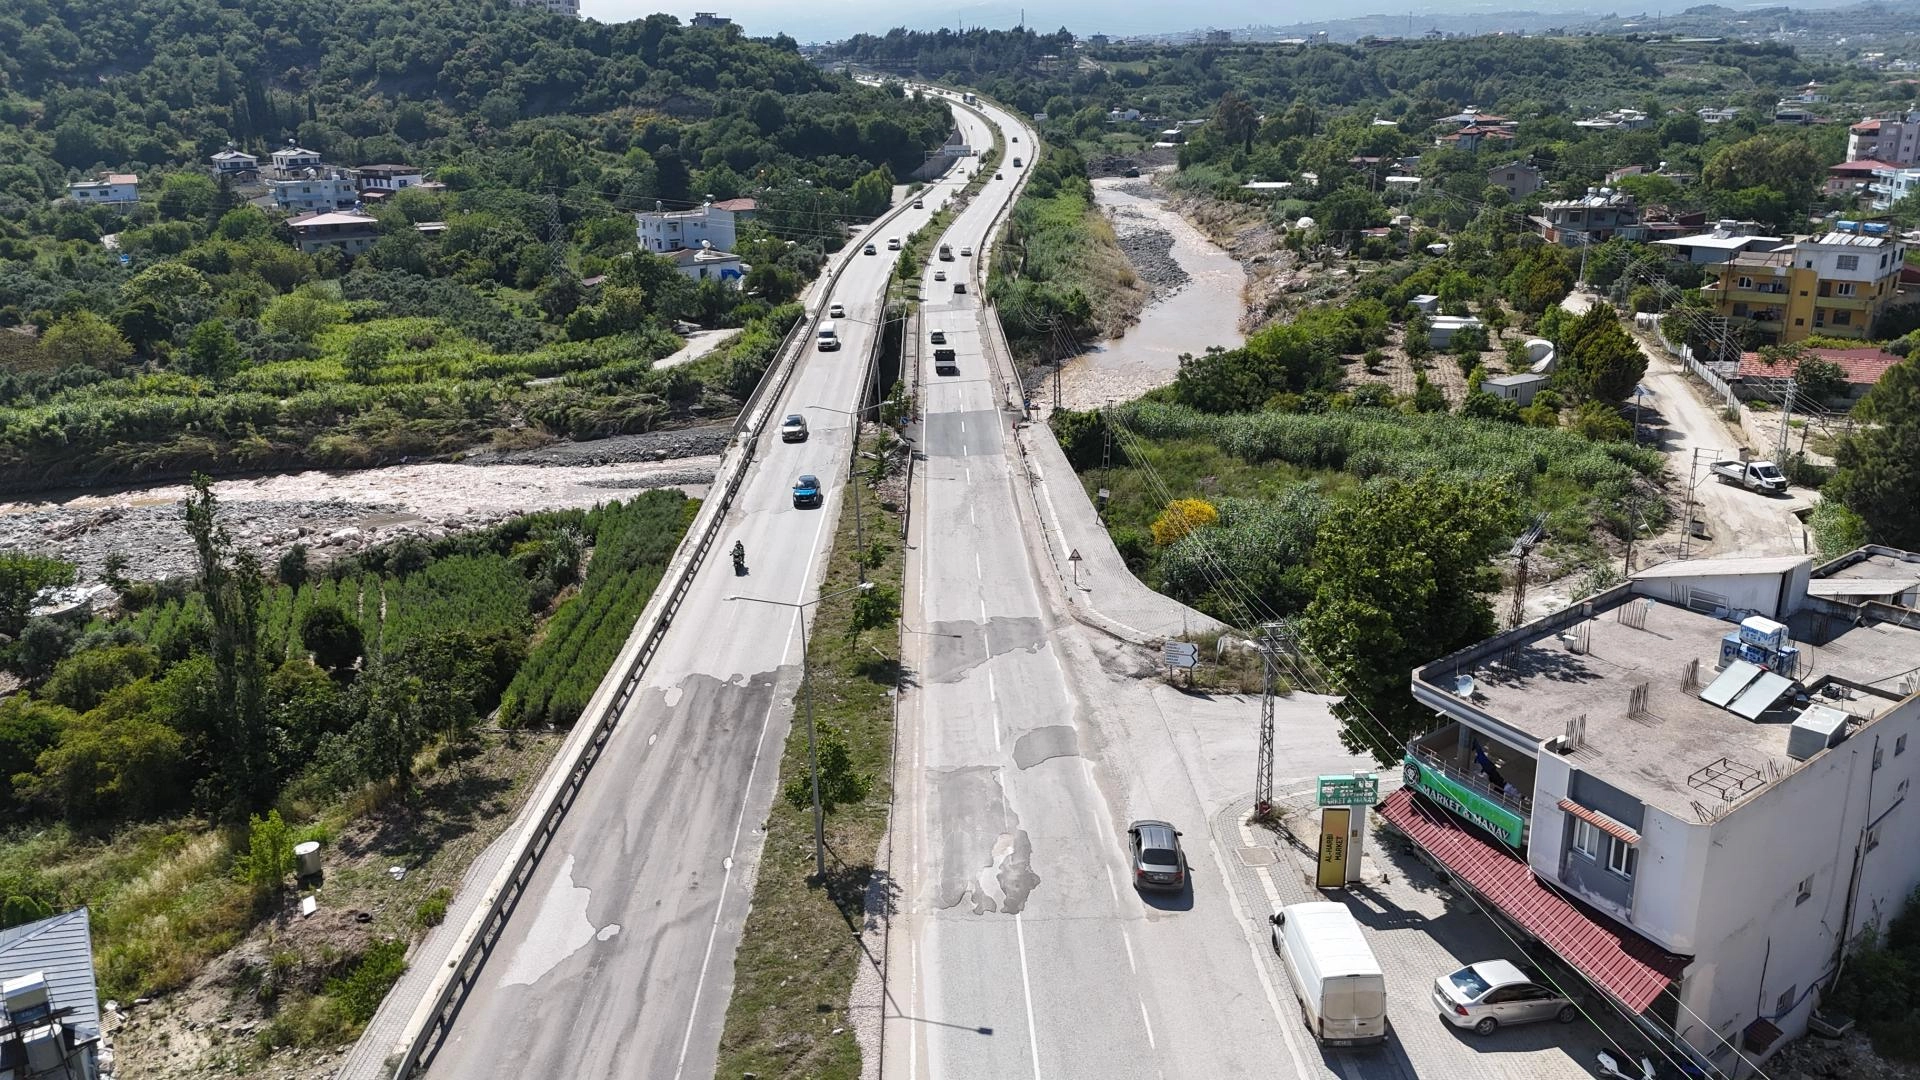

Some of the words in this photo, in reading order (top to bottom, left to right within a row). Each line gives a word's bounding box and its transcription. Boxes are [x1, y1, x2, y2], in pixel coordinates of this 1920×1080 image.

[1422, 784, 1461, 813] MARKET
[1462, 806, 1473, 819] &
[1473, 814, 1510, 839] MANAY
[1334, 836, 1343, 861] MARKET
